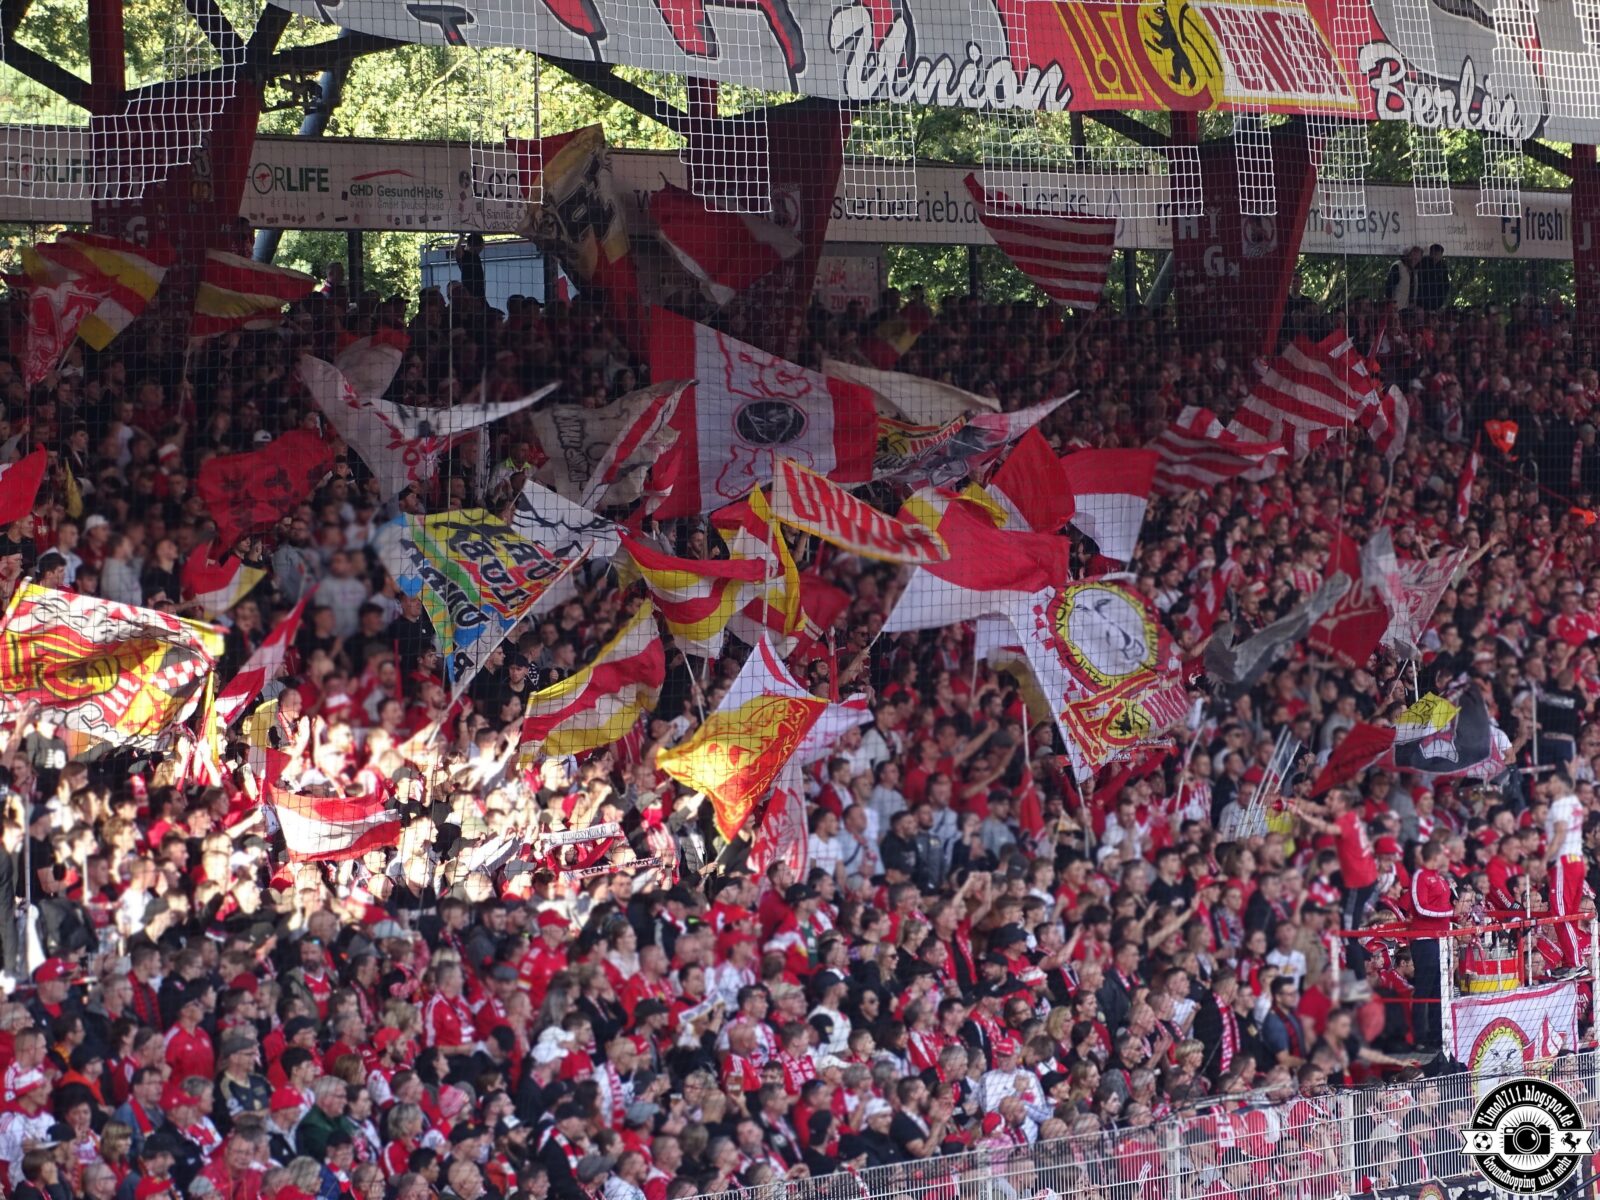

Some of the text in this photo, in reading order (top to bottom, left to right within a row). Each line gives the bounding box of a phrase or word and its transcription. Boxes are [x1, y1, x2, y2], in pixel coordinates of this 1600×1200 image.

[828, 3, 1074, 111] Union
[1202, 6, 1353, 98] UNION
[1359, 41, 1524, 140] Berlin
[251, 163, 330, 195] ORLIFE
[350, 184, 374, 197] GHD
[781, 452, 943, 561] UNION
